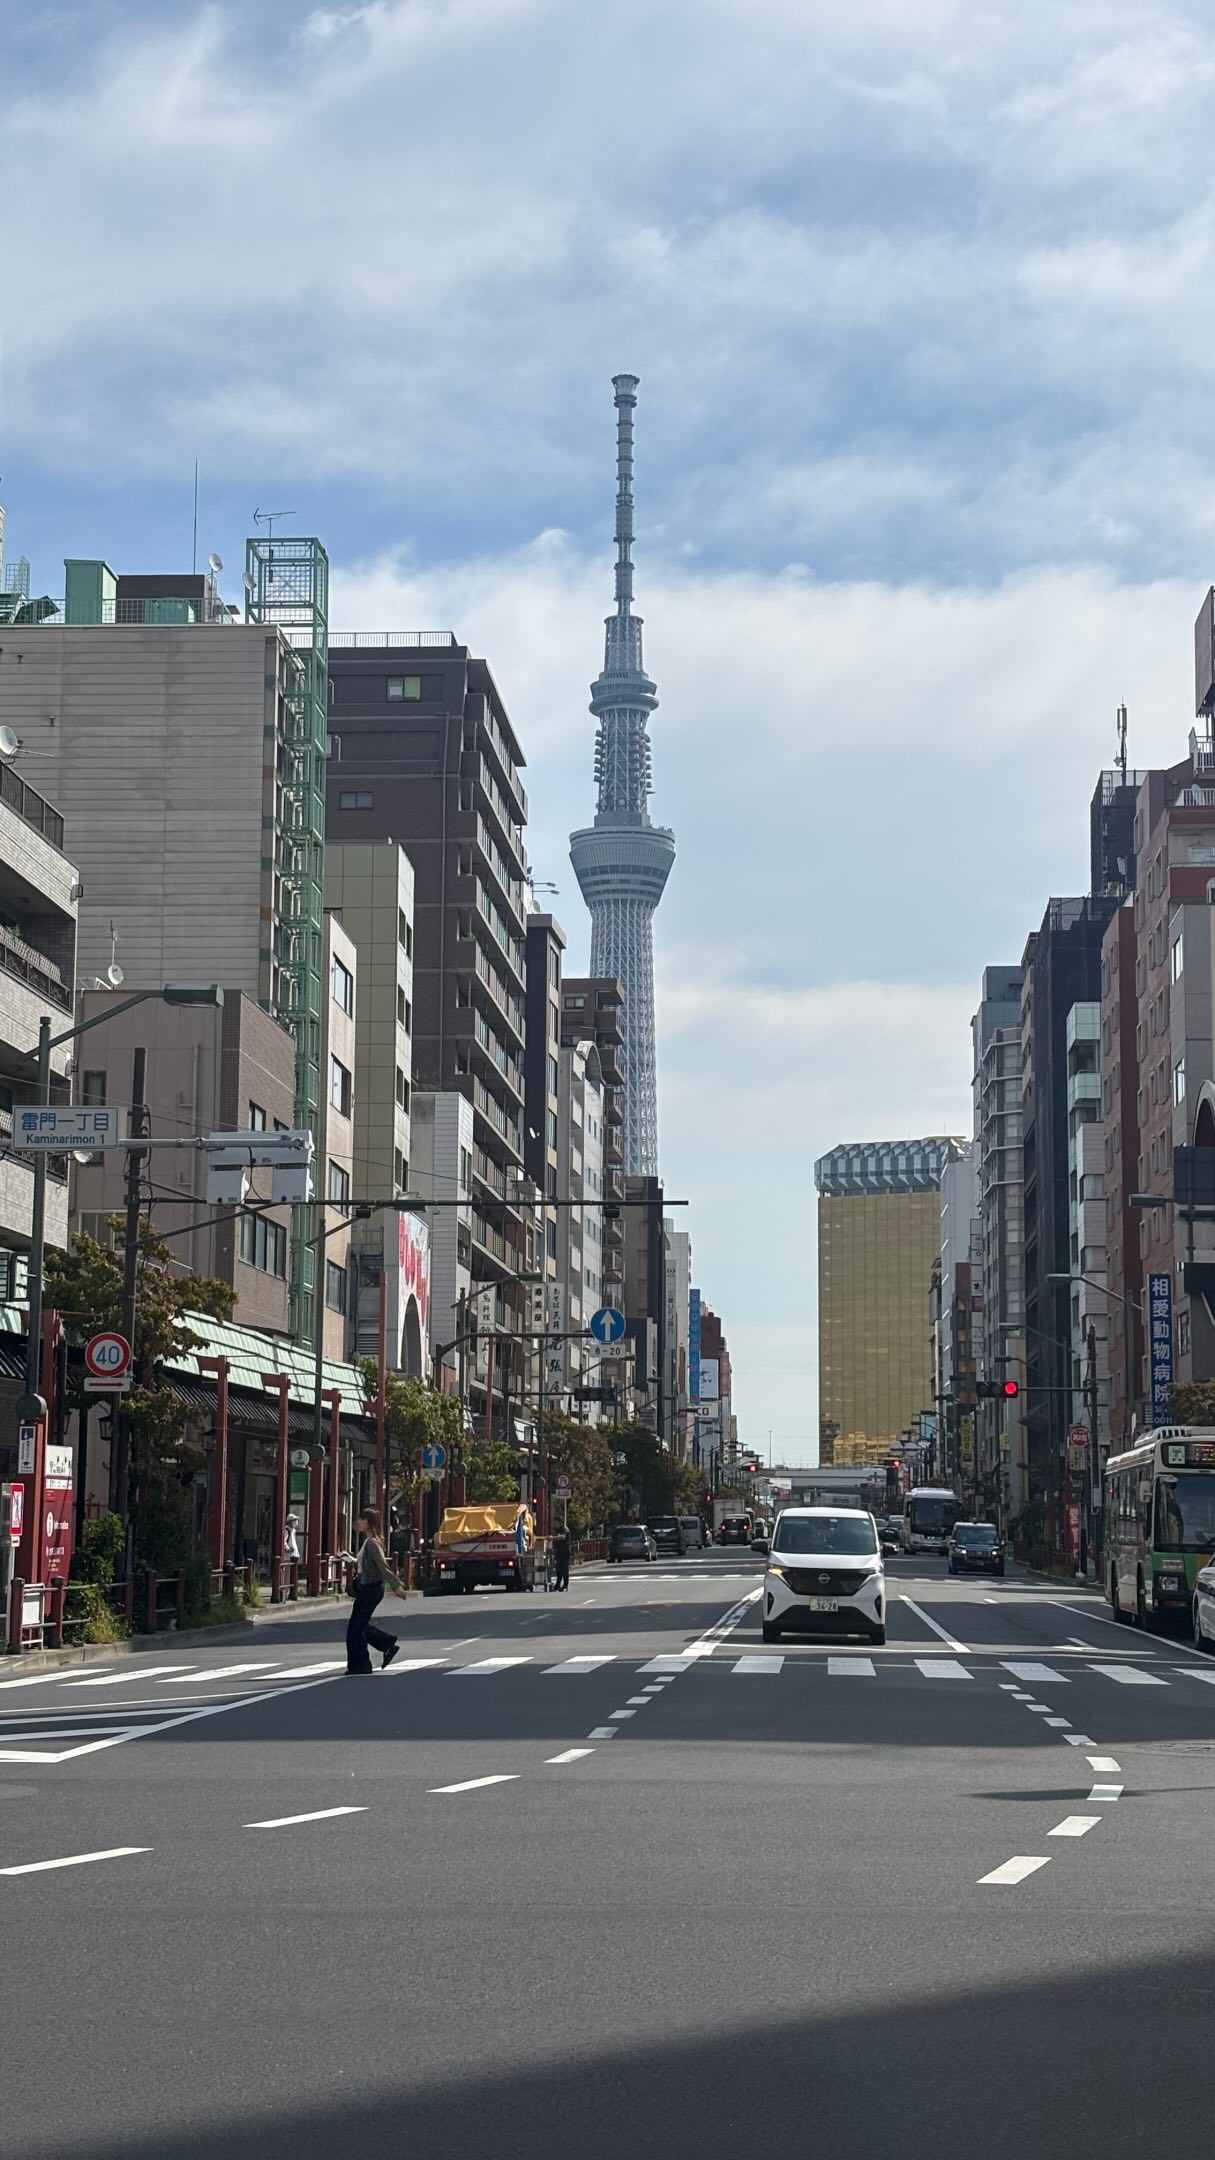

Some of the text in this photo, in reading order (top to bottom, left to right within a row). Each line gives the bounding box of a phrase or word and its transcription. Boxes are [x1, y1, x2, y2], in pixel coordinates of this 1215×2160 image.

[22, 1112, 109, 1131] 雷門一丁目
[26, 1133, 105, 1144] Kaminarimon 1
[1152, 1278, 1171, 1402] 相愛動物病院
[96, 1345, 120, 1365] 40
[296, 1451, 303, 1460] 3
